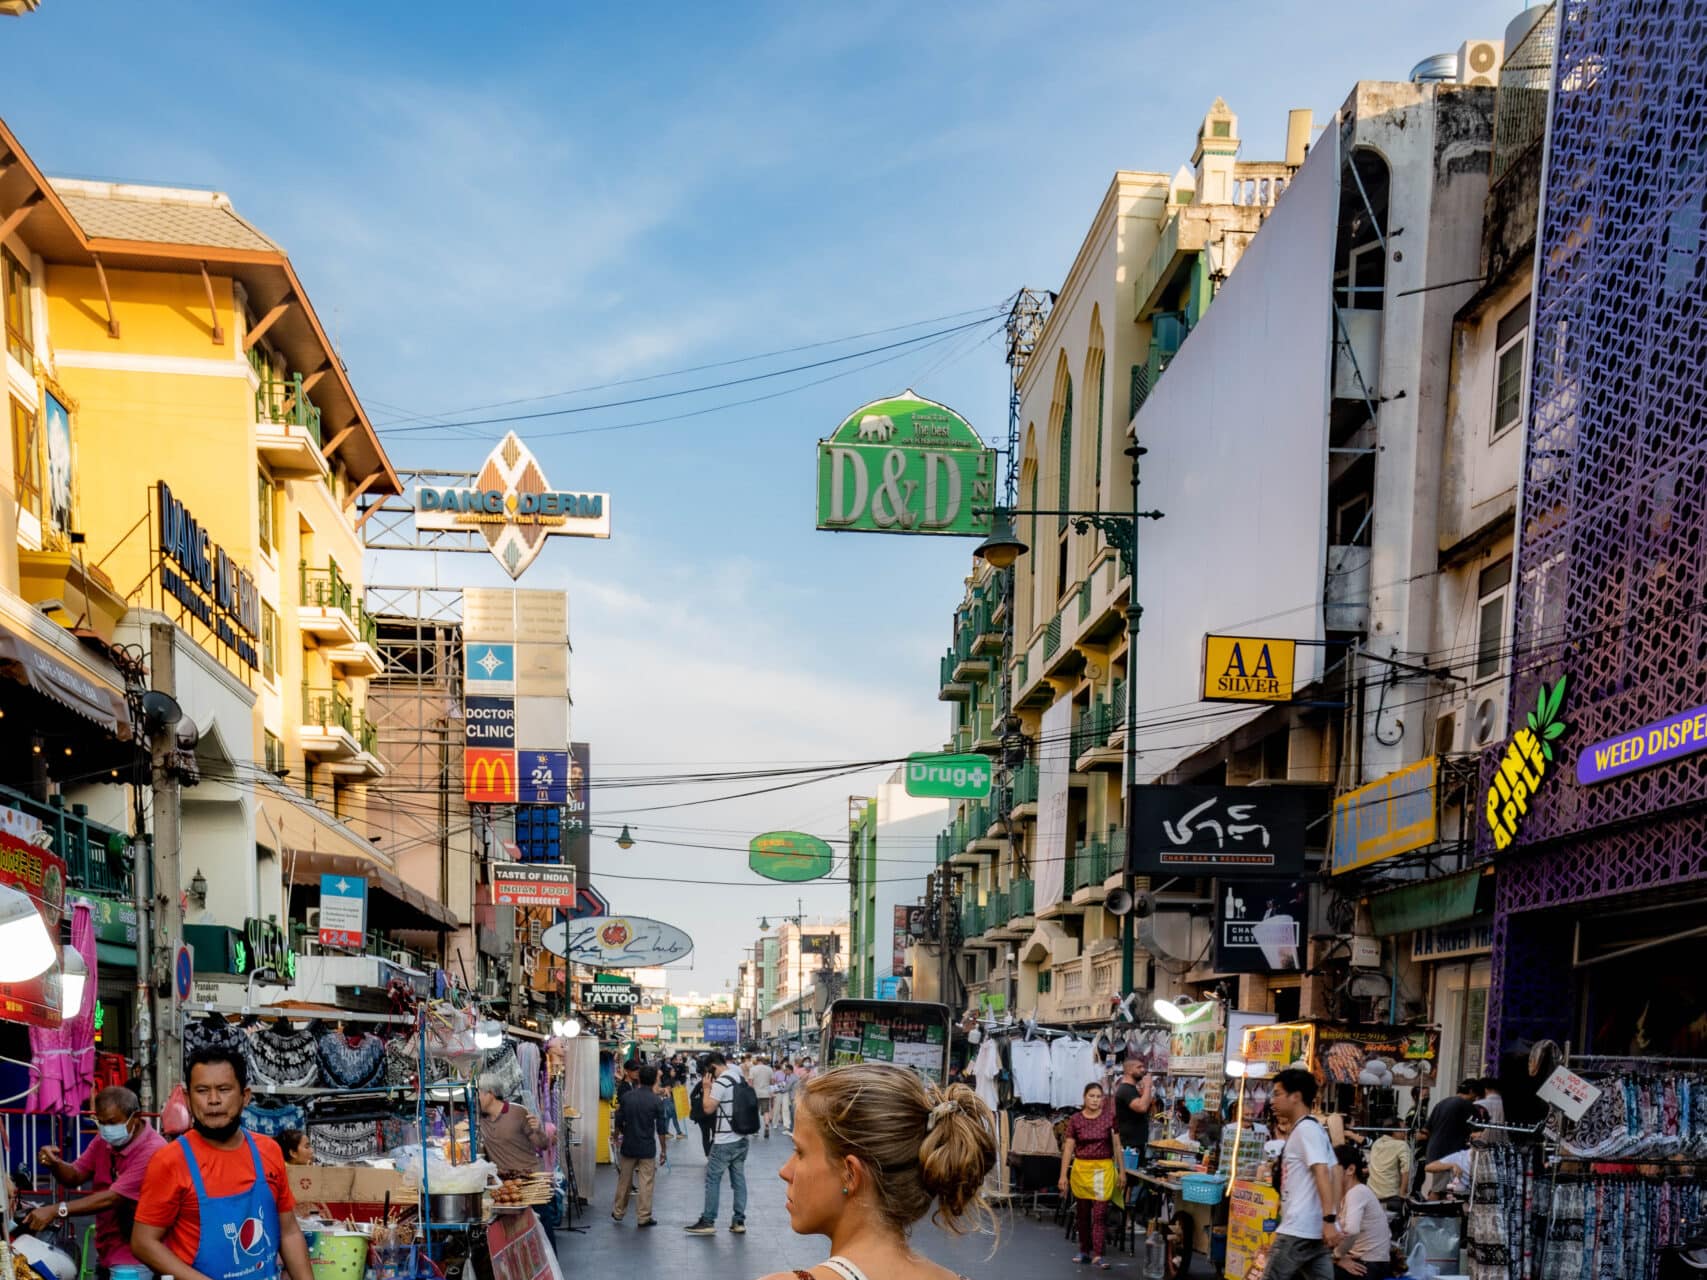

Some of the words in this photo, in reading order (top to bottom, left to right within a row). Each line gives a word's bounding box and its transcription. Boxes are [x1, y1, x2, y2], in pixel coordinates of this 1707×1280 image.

[913, 422, 929, 436] The
[825, 447, 962, 529] D&D
[420, 487, 503, 513] DANG
[518, 493, 602, 519] DERM
[1218, 677, 1280, 693] SILVER
[466, 708, 514, 719] DOCTOR
[466, 724, 514, 738] CLINIC
[1595, 734, 1645, 772] WEED
[531, 769, 553, 784] 24
[1487, 727, 1537, 830] PINE
[1494, 741, 1545, 850] APPLE
[496, 871, 526, 880] TASTE
[528, 872, 540, 880] OF
[543, 873, 569, 882] INDIA
[499, 884, 537, 894] INDIAN
[541, 886, 570, 896] FOOD
[584, 993, 639, 1004] TATTOO
